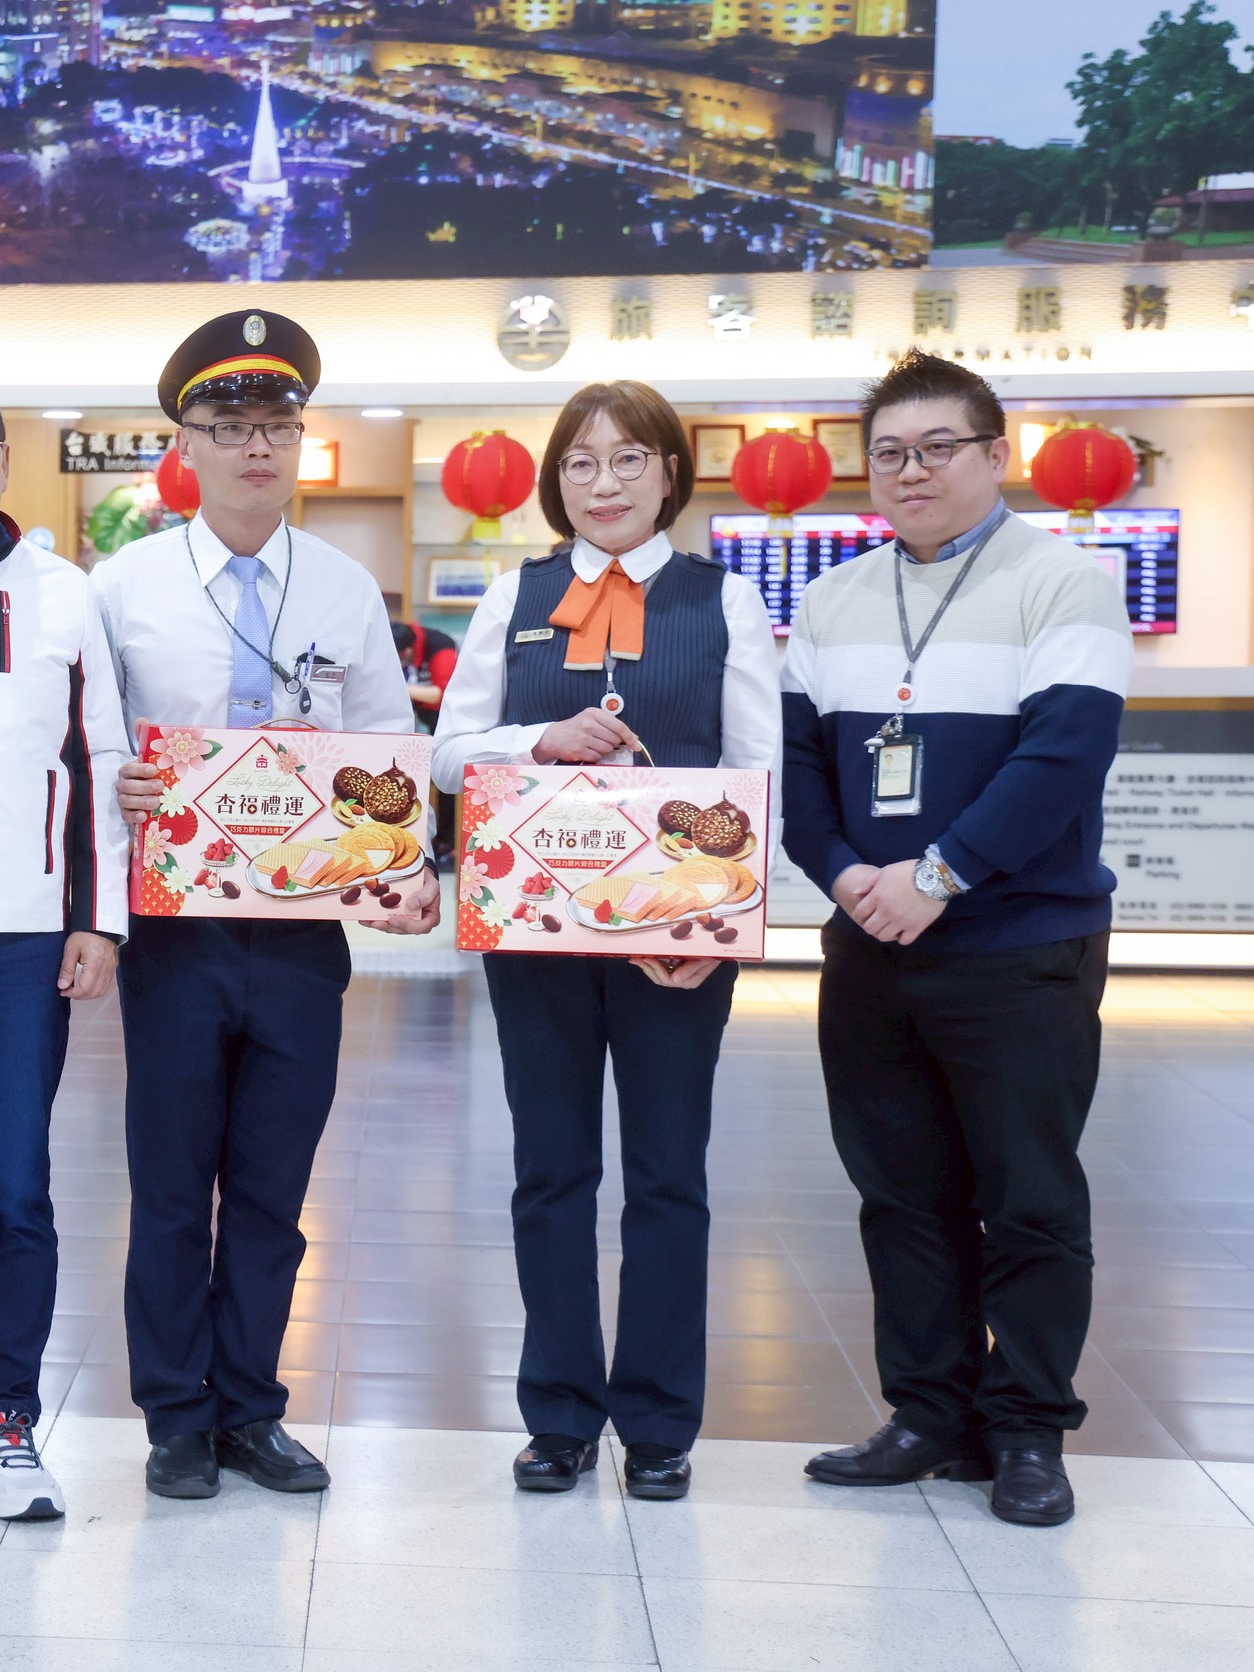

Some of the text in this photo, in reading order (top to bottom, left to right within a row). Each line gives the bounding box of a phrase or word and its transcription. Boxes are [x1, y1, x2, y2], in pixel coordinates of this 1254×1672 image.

[873, 346, 1093, 361] INORMATION
[66, 457, 159, 471] TRA Informa
[215, 793, 304, 816] 杏福禮運
[532, 828, 626, 849] 杏福禮運
